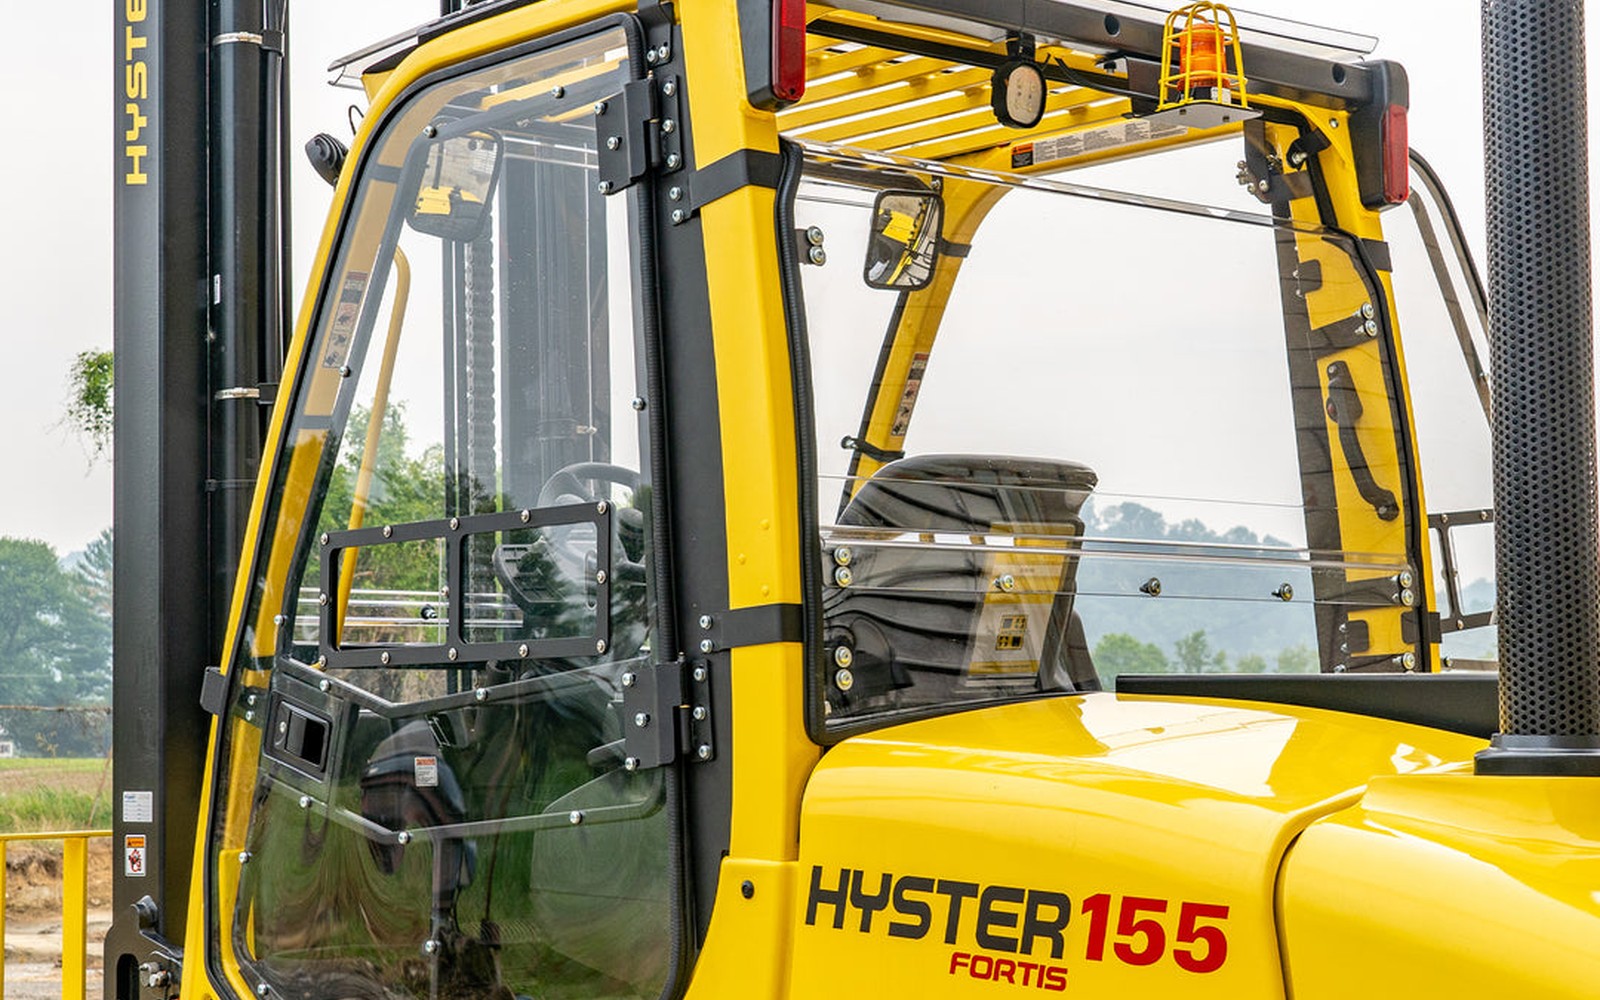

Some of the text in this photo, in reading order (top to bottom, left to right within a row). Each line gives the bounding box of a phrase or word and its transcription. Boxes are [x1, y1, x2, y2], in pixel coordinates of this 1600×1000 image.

[805, 865, 1230, 974] HYSTER 155
[949, 951, 1068, 992] FORTIS
